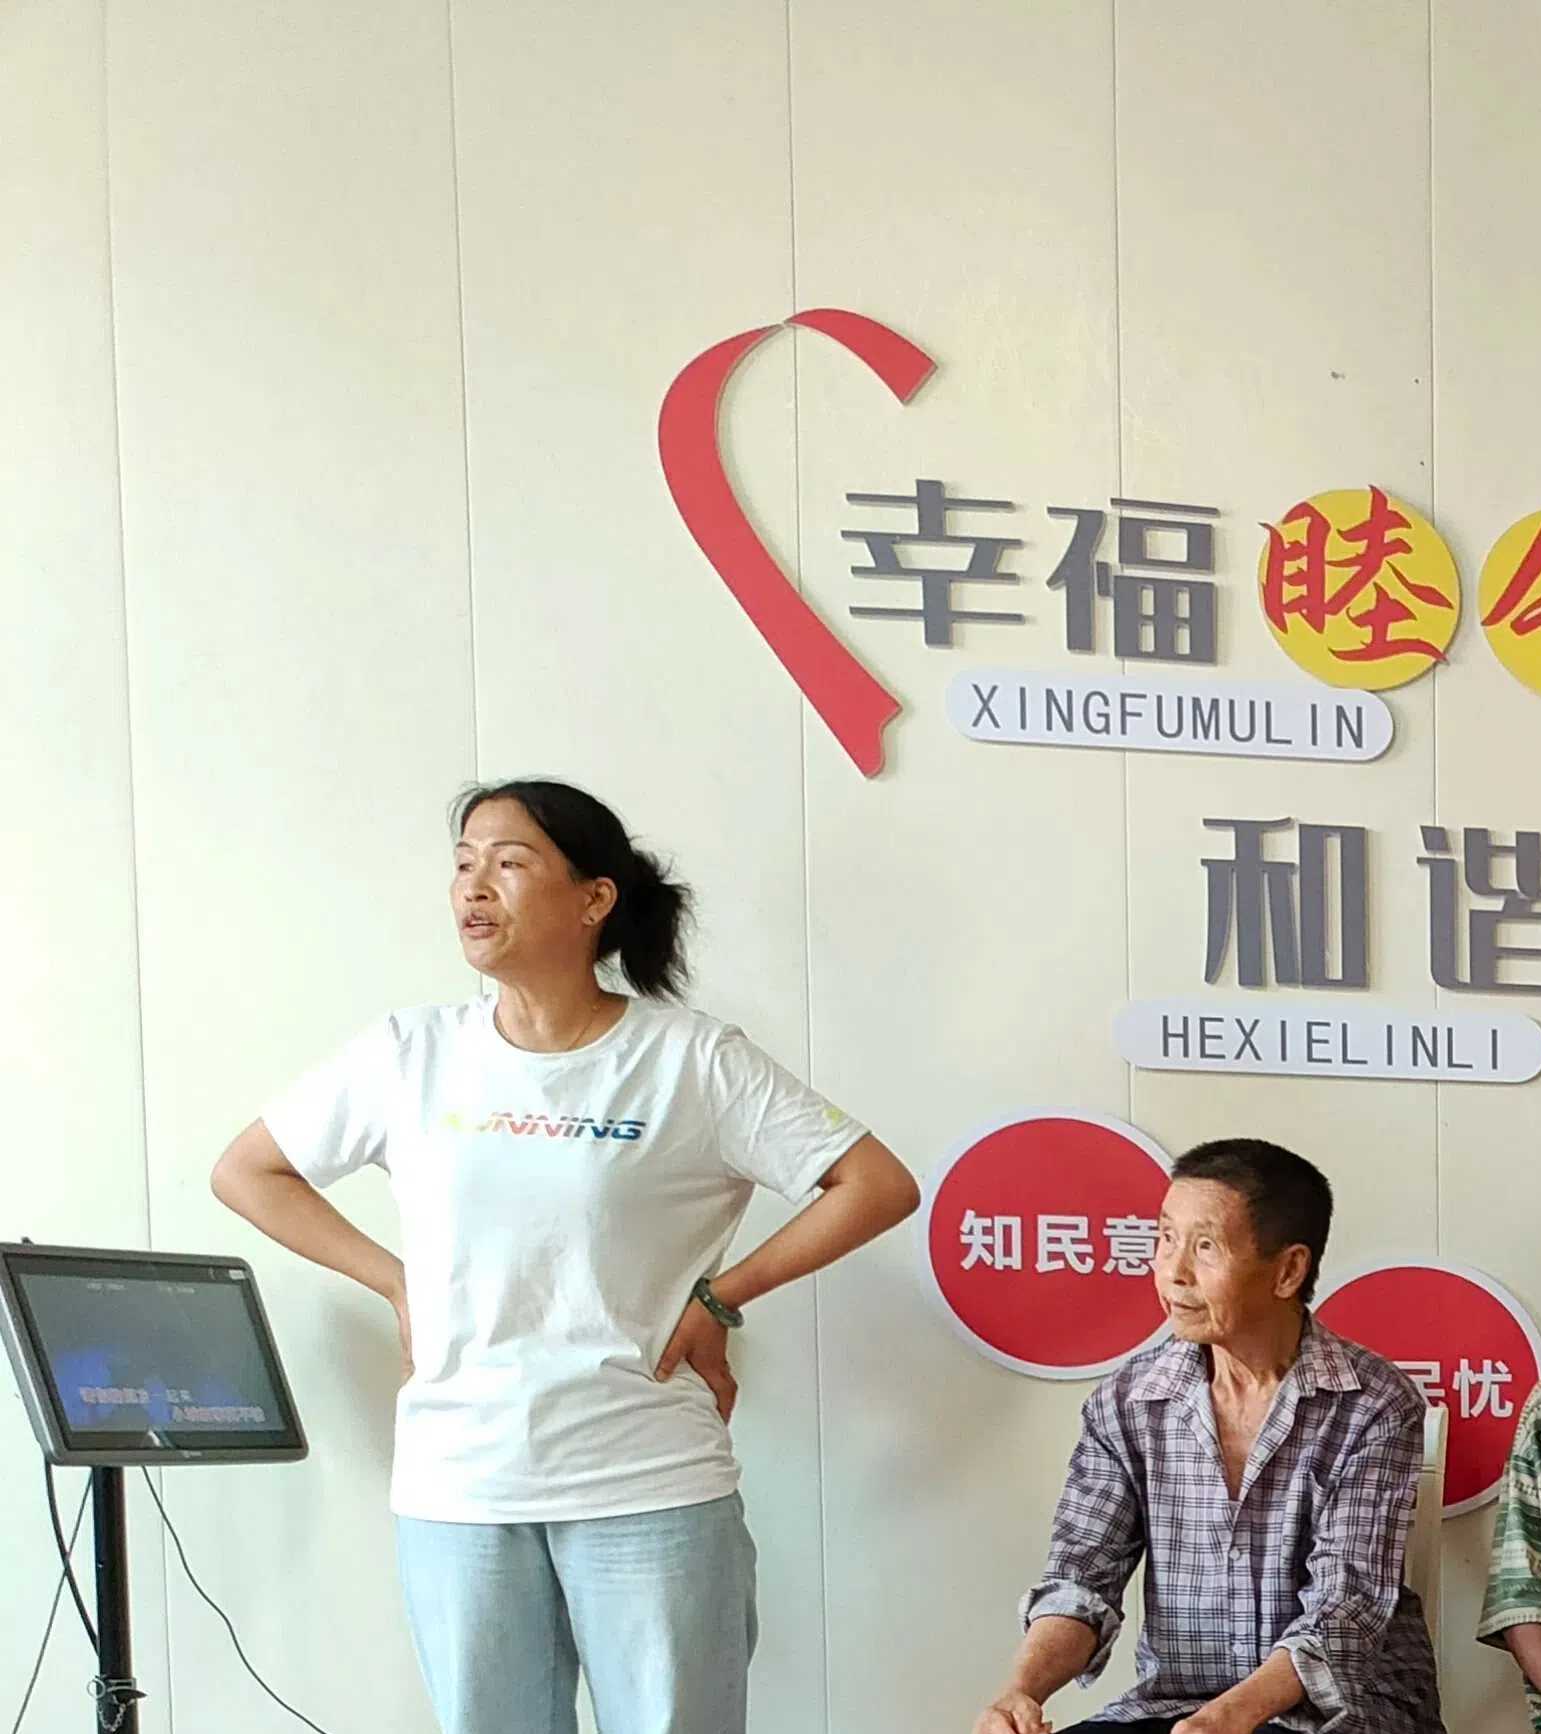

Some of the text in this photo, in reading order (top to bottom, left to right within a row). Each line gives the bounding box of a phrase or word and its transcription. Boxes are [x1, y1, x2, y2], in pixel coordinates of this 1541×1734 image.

[970, 682, 1366, 750] XINGFUMULIN
[1160, 1014, 1501, 1071] HEXIELINLI
[444, 1111, 646, 1141] NNING
[959, 1209, 1159, 1276] 知民意
